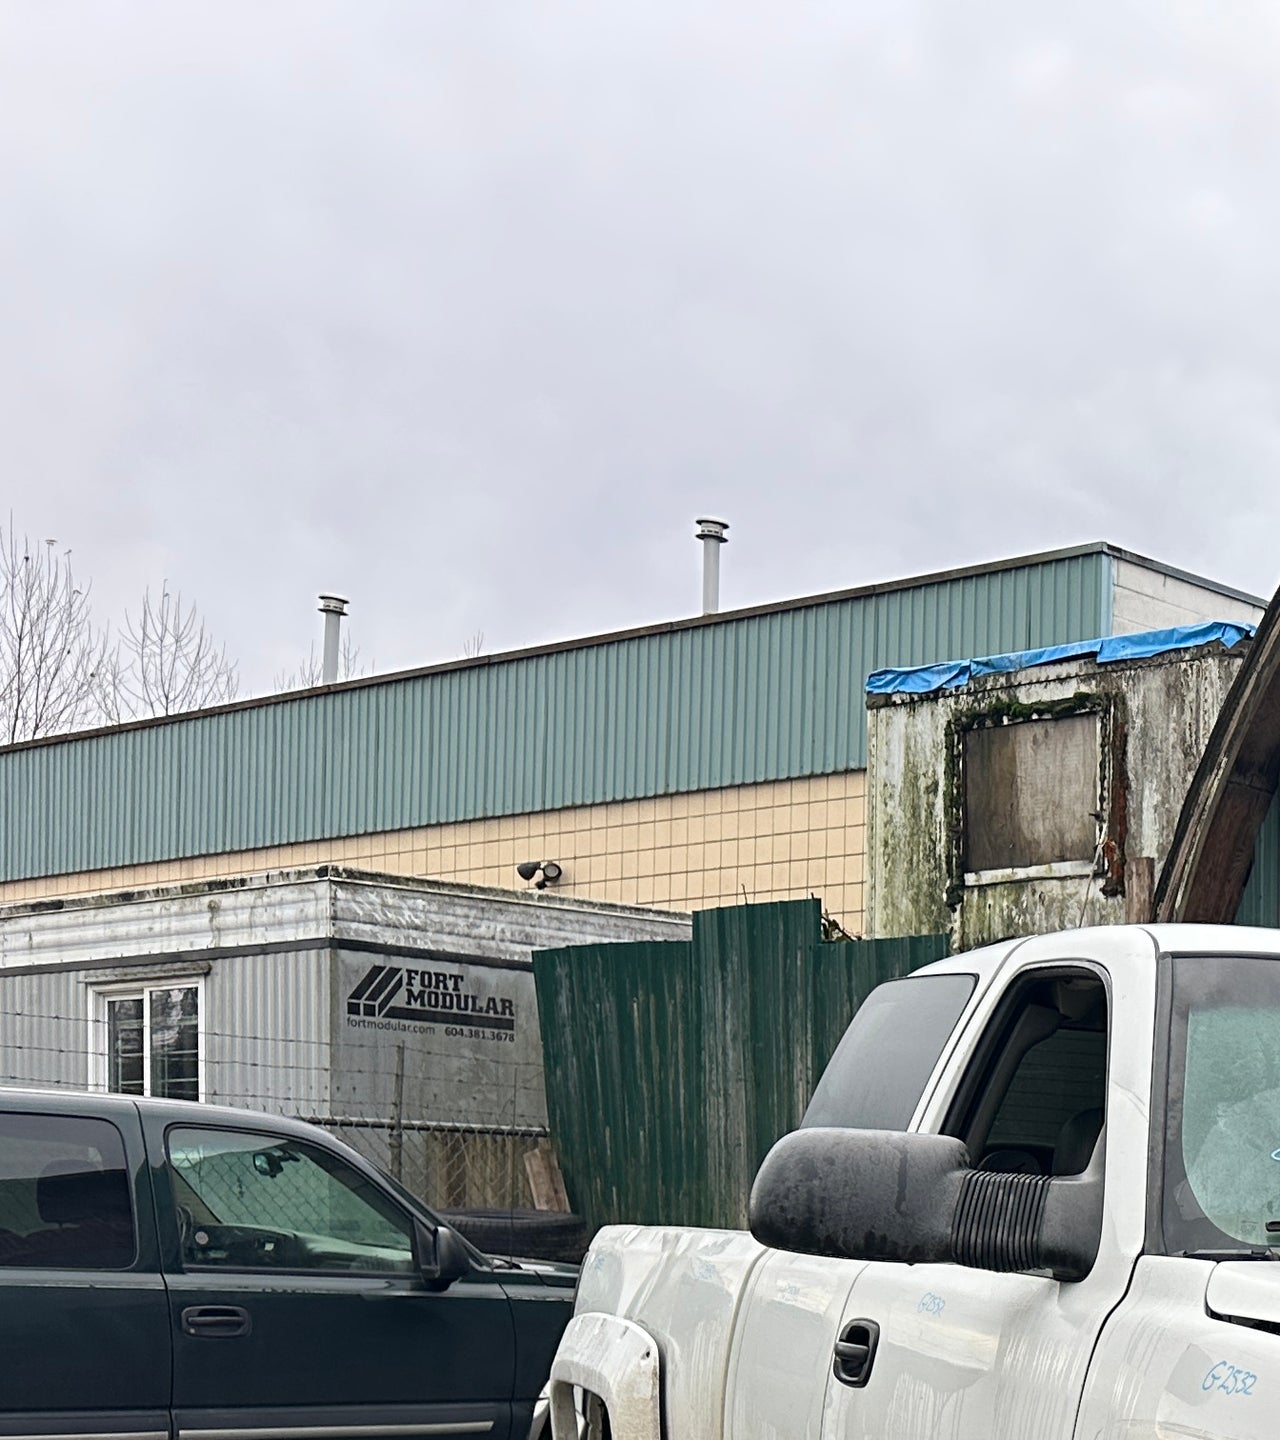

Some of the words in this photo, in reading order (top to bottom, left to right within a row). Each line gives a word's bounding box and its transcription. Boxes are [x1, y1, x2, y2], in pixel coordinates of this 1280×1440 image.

[405, 968, 464, 992] FORT
[405, 988, 515, 1017] MODULAR
[347, 1017, 436, 1036] fortmodular.com
[444, 1026, 515, 1043] 604.381.3678
[1202, 1360, 1258, 1395] G2532
